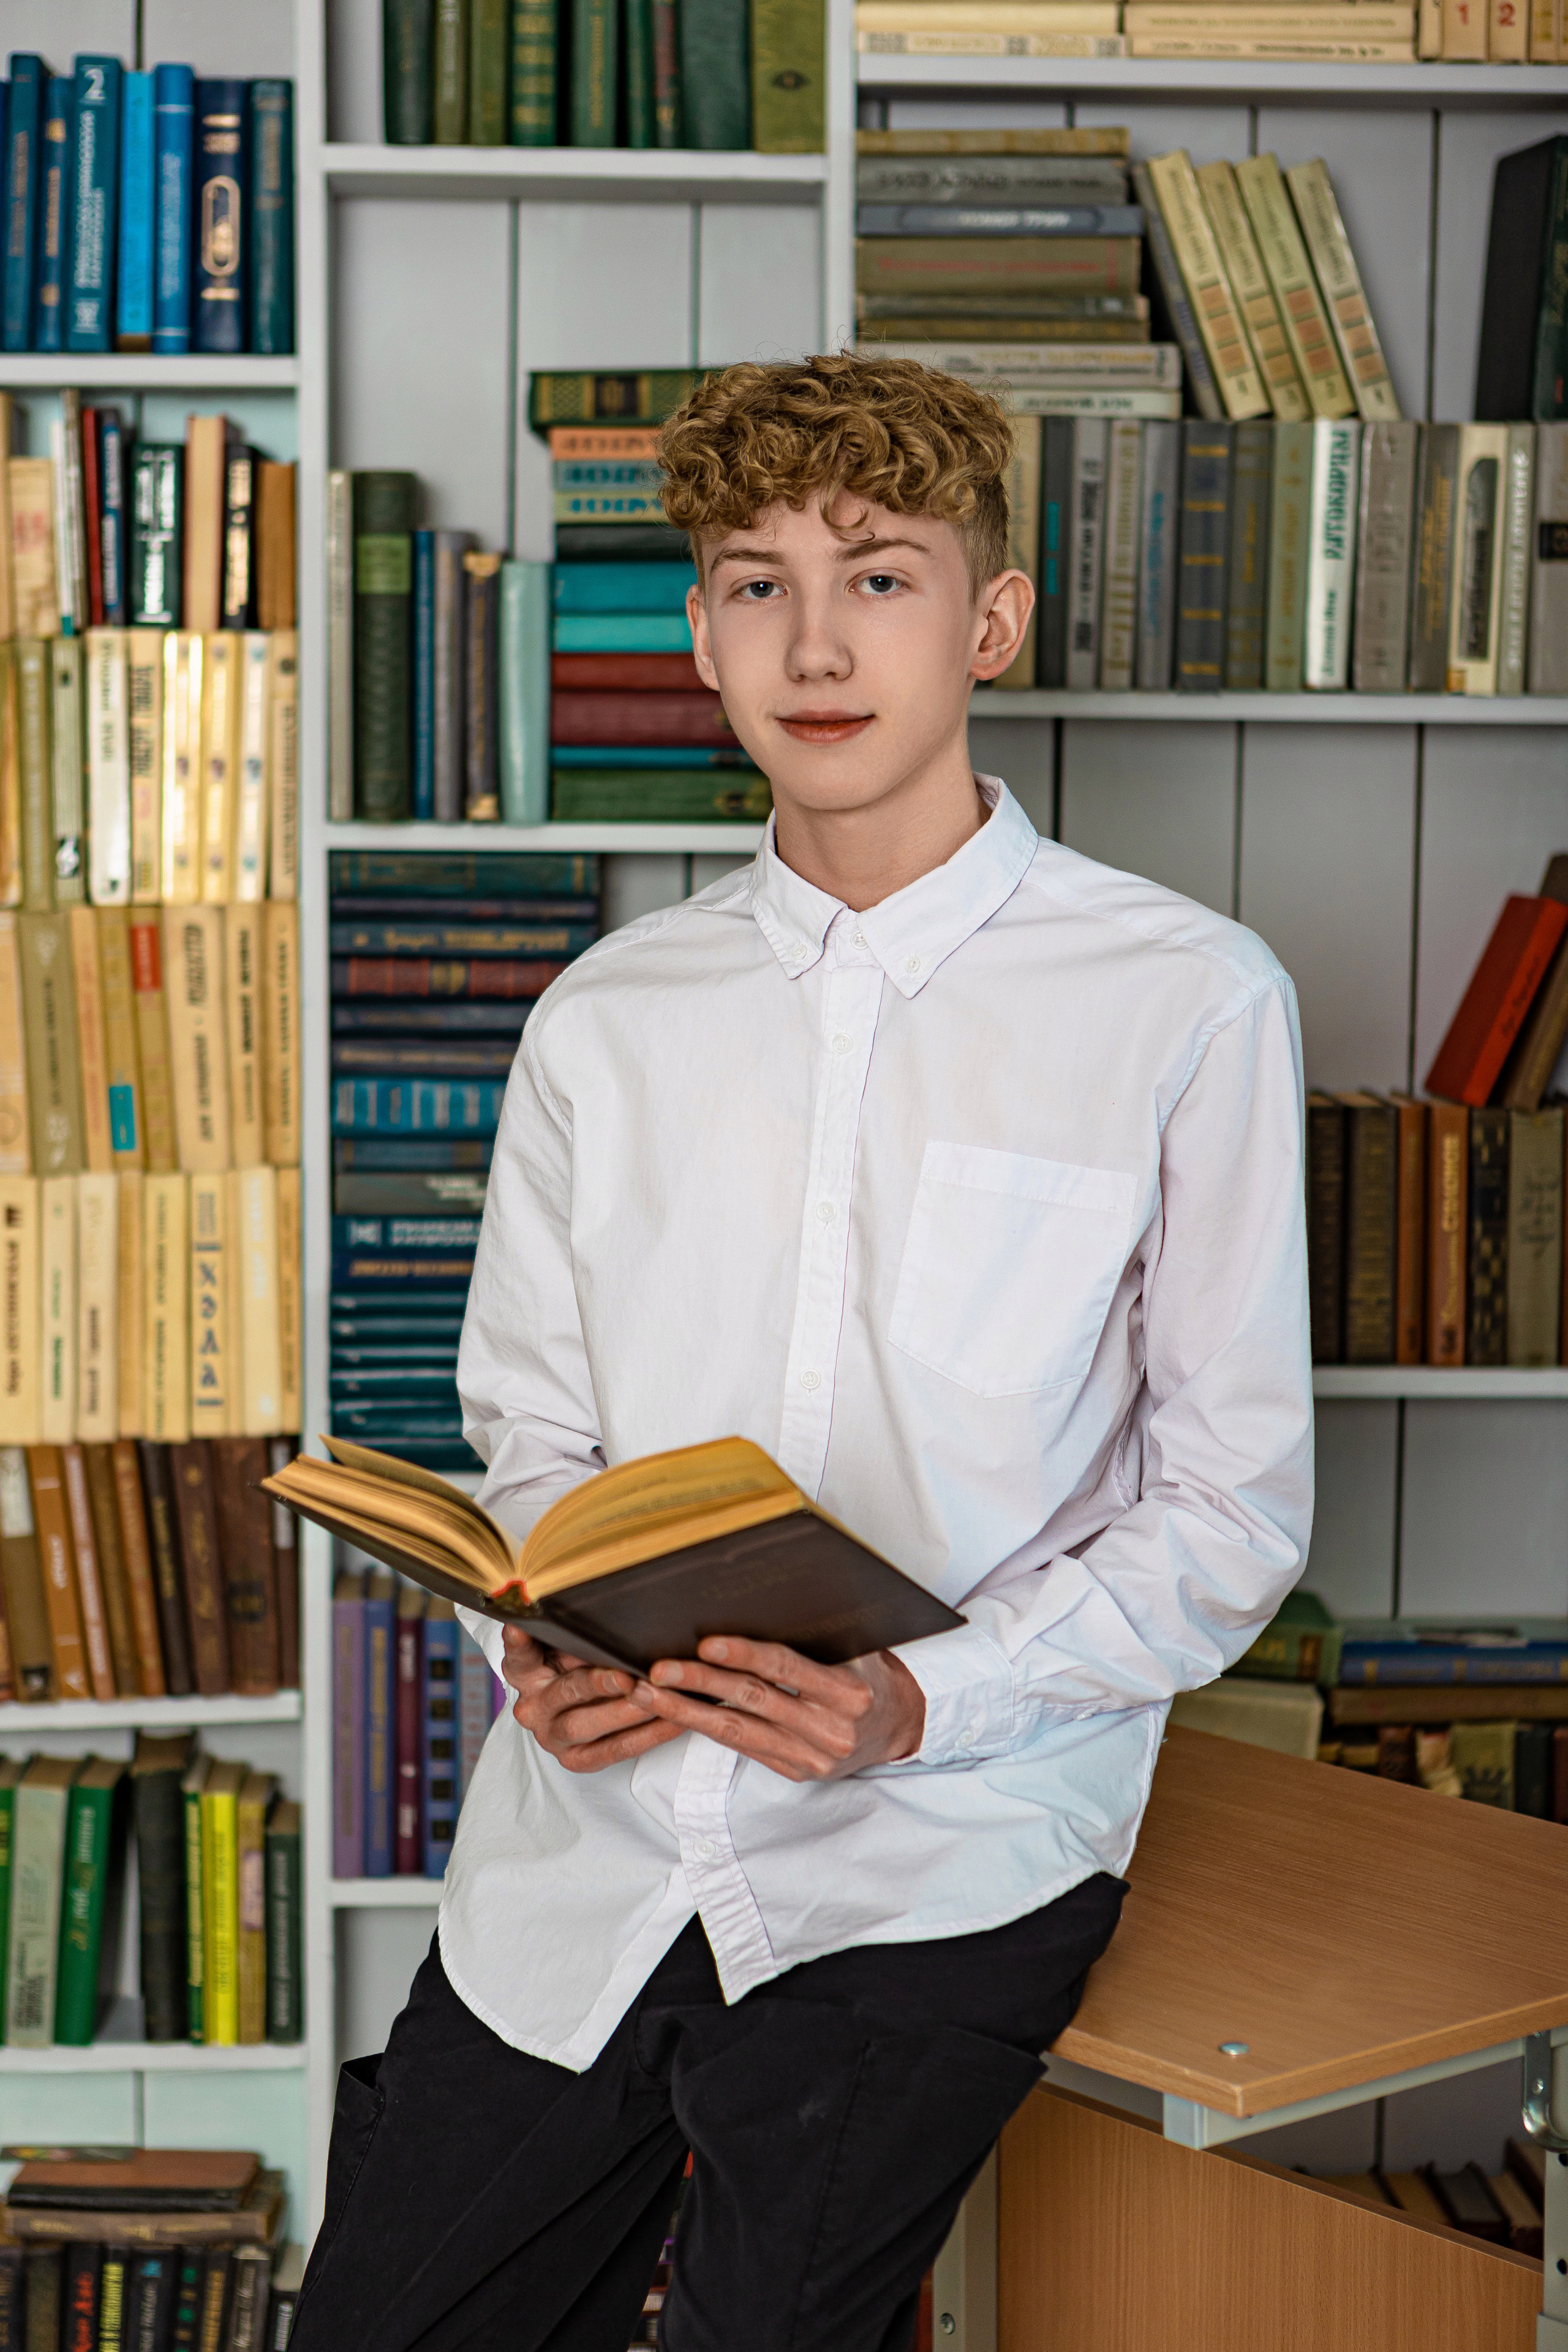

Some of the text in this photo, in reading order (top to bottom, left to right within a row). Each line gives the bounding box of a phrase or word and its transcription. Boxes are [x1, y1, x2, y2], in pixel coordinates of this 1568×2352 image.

[1457, 3, 1471, 26] 1
[1499, 3, 1516, 26] 2
[84, 68, 105, 101] 2
